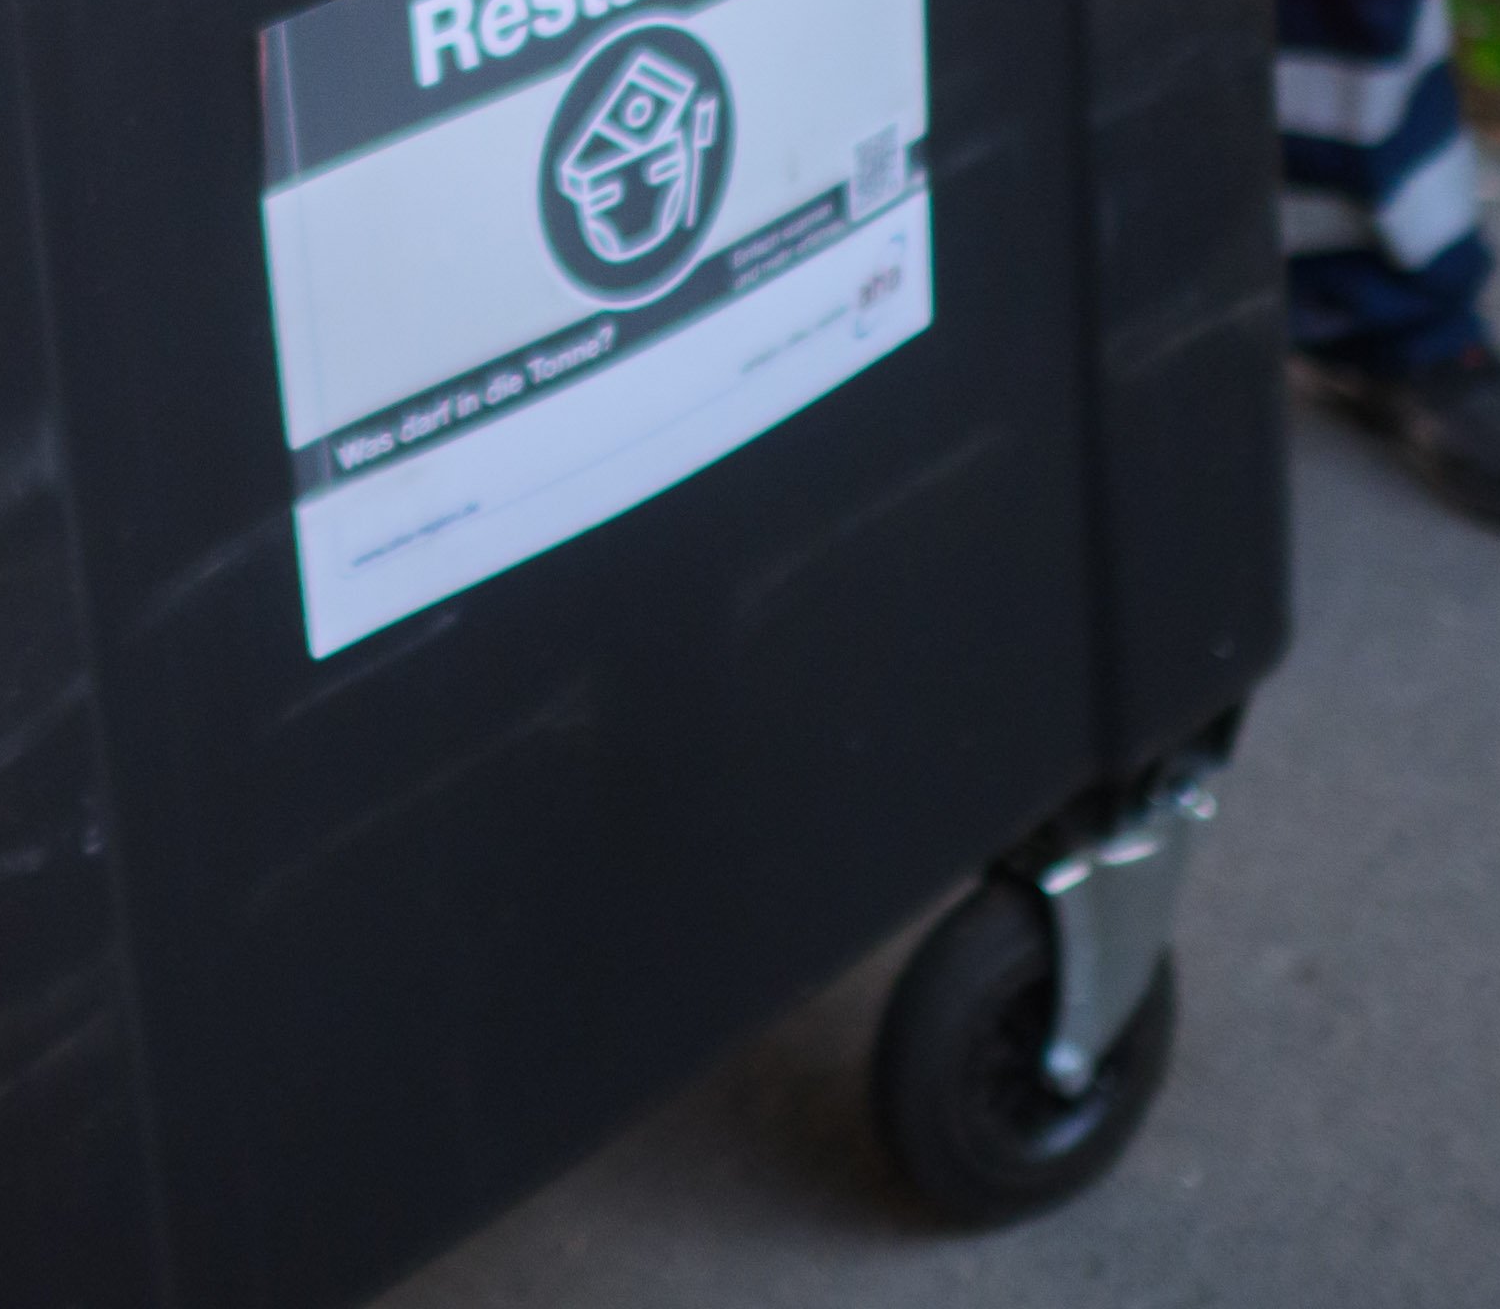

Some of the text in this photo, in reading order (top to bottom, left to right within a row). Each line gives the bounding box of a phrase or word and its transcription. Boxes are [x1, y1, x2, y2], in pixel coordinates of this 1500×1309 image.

[336, 323, 615, 471] Was darf in die Tonne?
